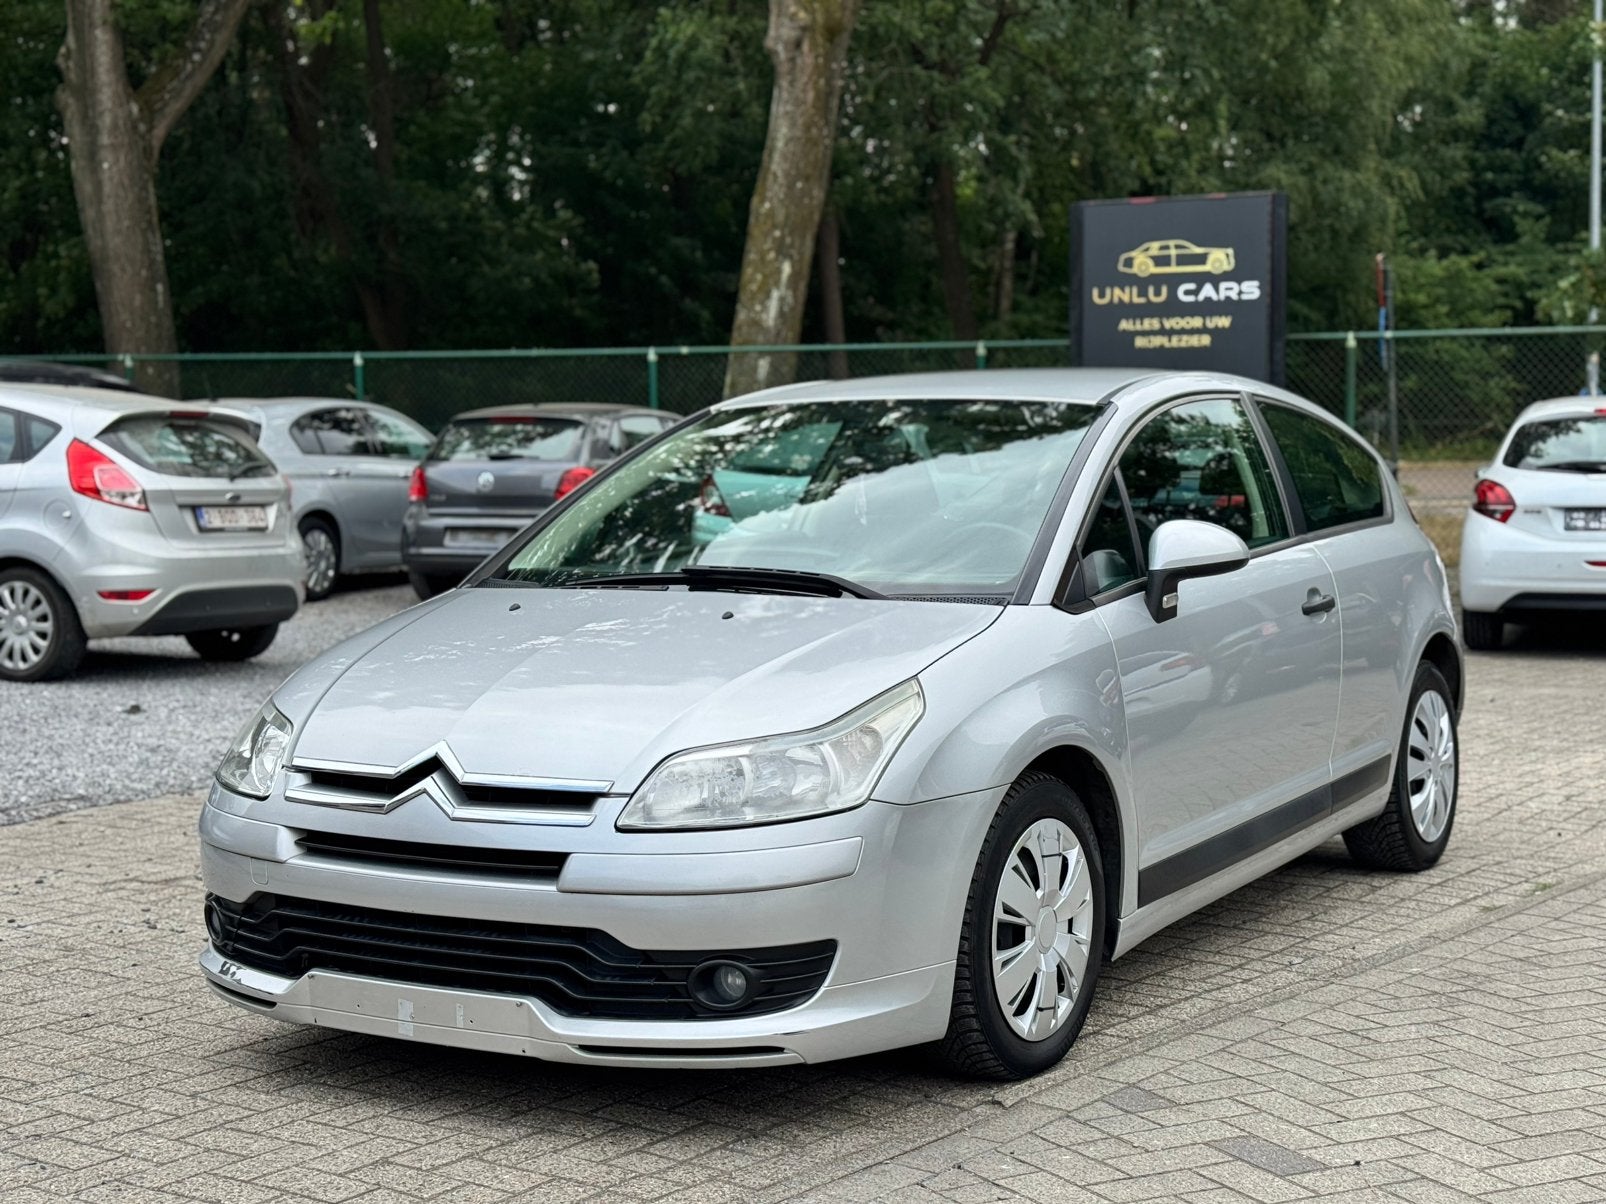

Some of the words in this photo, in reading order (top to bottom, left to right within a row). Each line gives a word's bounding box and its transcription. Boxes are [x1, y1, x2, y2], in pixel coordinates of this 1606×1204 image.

[1092, 285, 1168, 305] UNLU
[1177, 281, 1261, 302] CARS
[1118, 317, 1161, 331] ALLES
[1162, 316, 1203, 330] VOOR
[1206, 315, 1232, 328] UW
